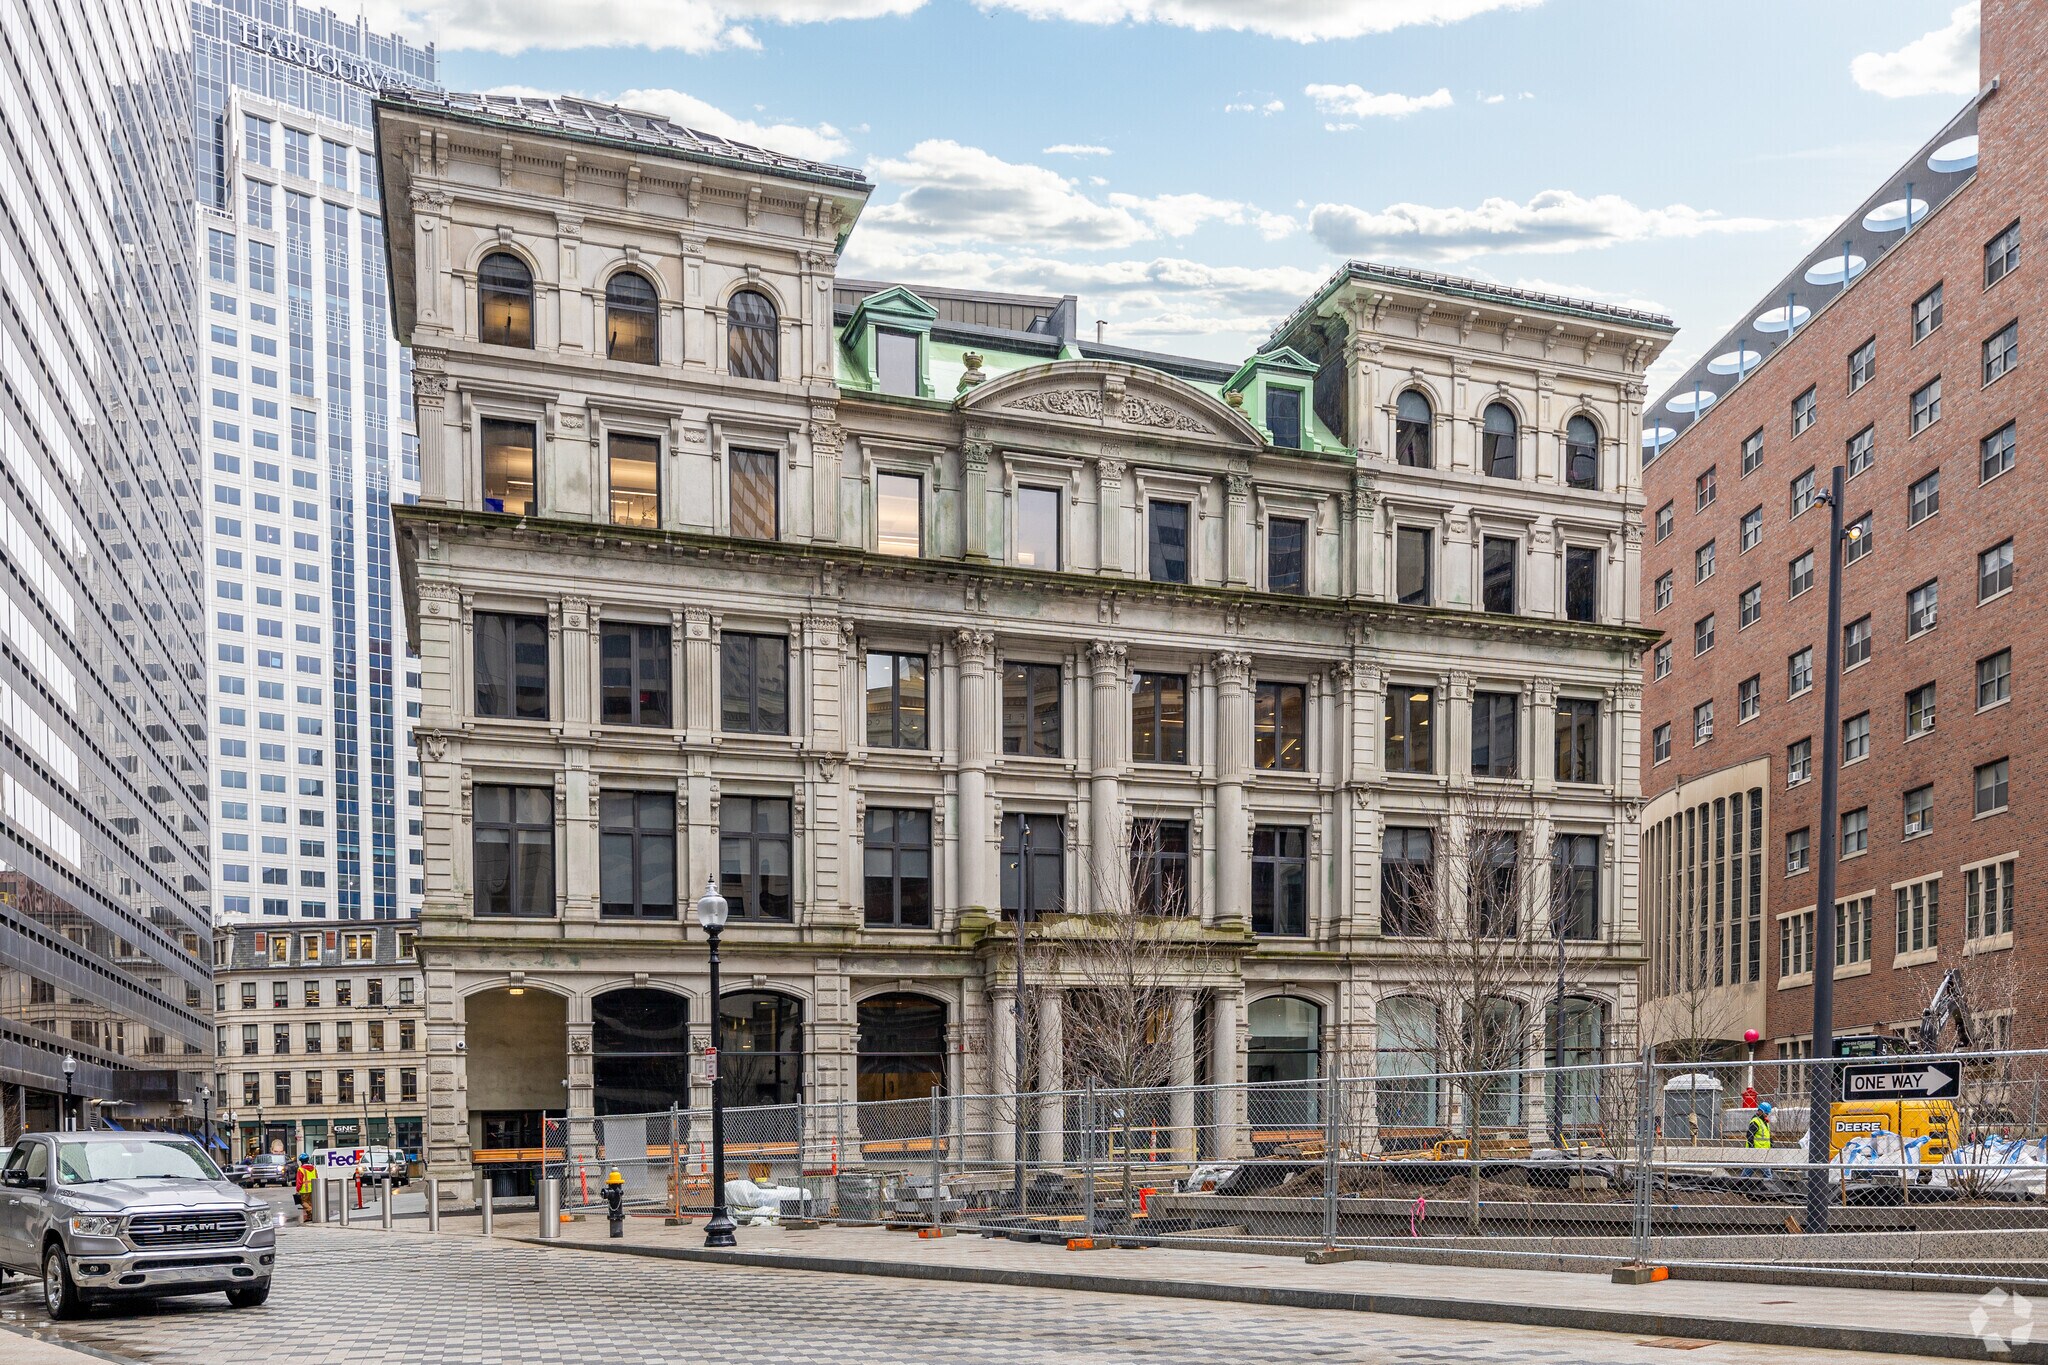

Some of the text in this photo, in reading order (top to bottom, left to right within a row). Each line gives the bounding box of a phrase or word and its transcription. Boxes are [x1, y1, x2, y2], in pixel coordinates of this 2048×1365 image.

[240, 20, 416, 90] HARBOURV
[1854, 1074, 1924, 1090] ONE WAY
[1835, 1121, 1882, 1132] DEERE
[327, 1149, 365, 1167] FedE
[166, 1223, 215, 1232] RAM
